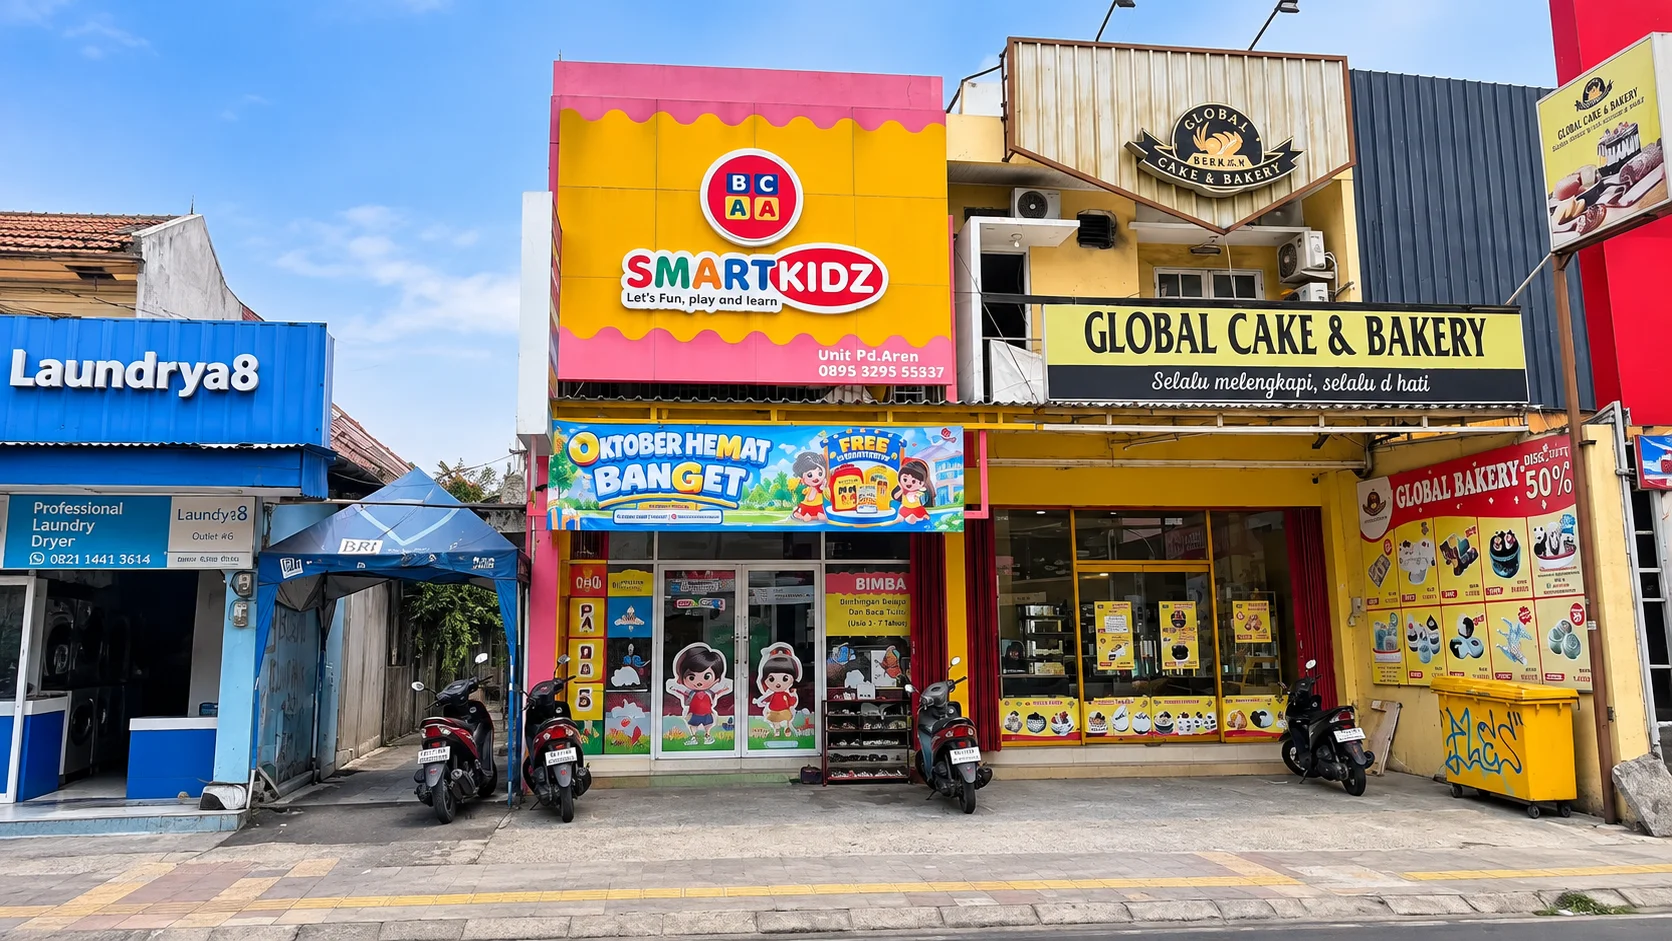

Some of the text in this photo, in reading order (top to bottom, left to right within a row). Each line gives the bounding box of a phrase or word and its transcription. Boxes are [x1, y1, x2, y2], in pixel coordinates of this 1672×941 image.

[1184, 108, 1248, 133] GLOBAL
[1557, 120, 1583, 140] GLOBAL
[1583, 108, 1602, 126] CAKE
[1610, 87, 1638, 112] BAKERY
[1158, 157, 1280, 185] CAKE & BAKERY
[626, 292, 778, 309] Let's Fun, play and learn
[1084, 310, 1487, 357] GLOBAL CAKE & BAKERY
[818, 348, 919, 363] Unit Pd.Aren
[9, 348, 259, 398] Laundrya8
[818, 365, 856, 378] 0895
[861, 366, 897, 379] 3295
[1151, 371, 1430, 399] Selalu melengkapi, selalu d hati
[568, 431, 772, 466] OKTOBER HEMAT
[838, 435, 890, 454] FREE
[594, 462, 748, 497] BANGET
[1396, 460, 1572, 509] GLOBAL BAKERY 50%
[34, 502, 123, 516] Professional
[33, 519, 95, 535] Laundry
[31, 535, 76, 551] Dryer
[50, 554, 151, 565] 0821 1441 3614
[855, 577, 907, 591] BIMBA
[848, 608, 864, 616] Dan
